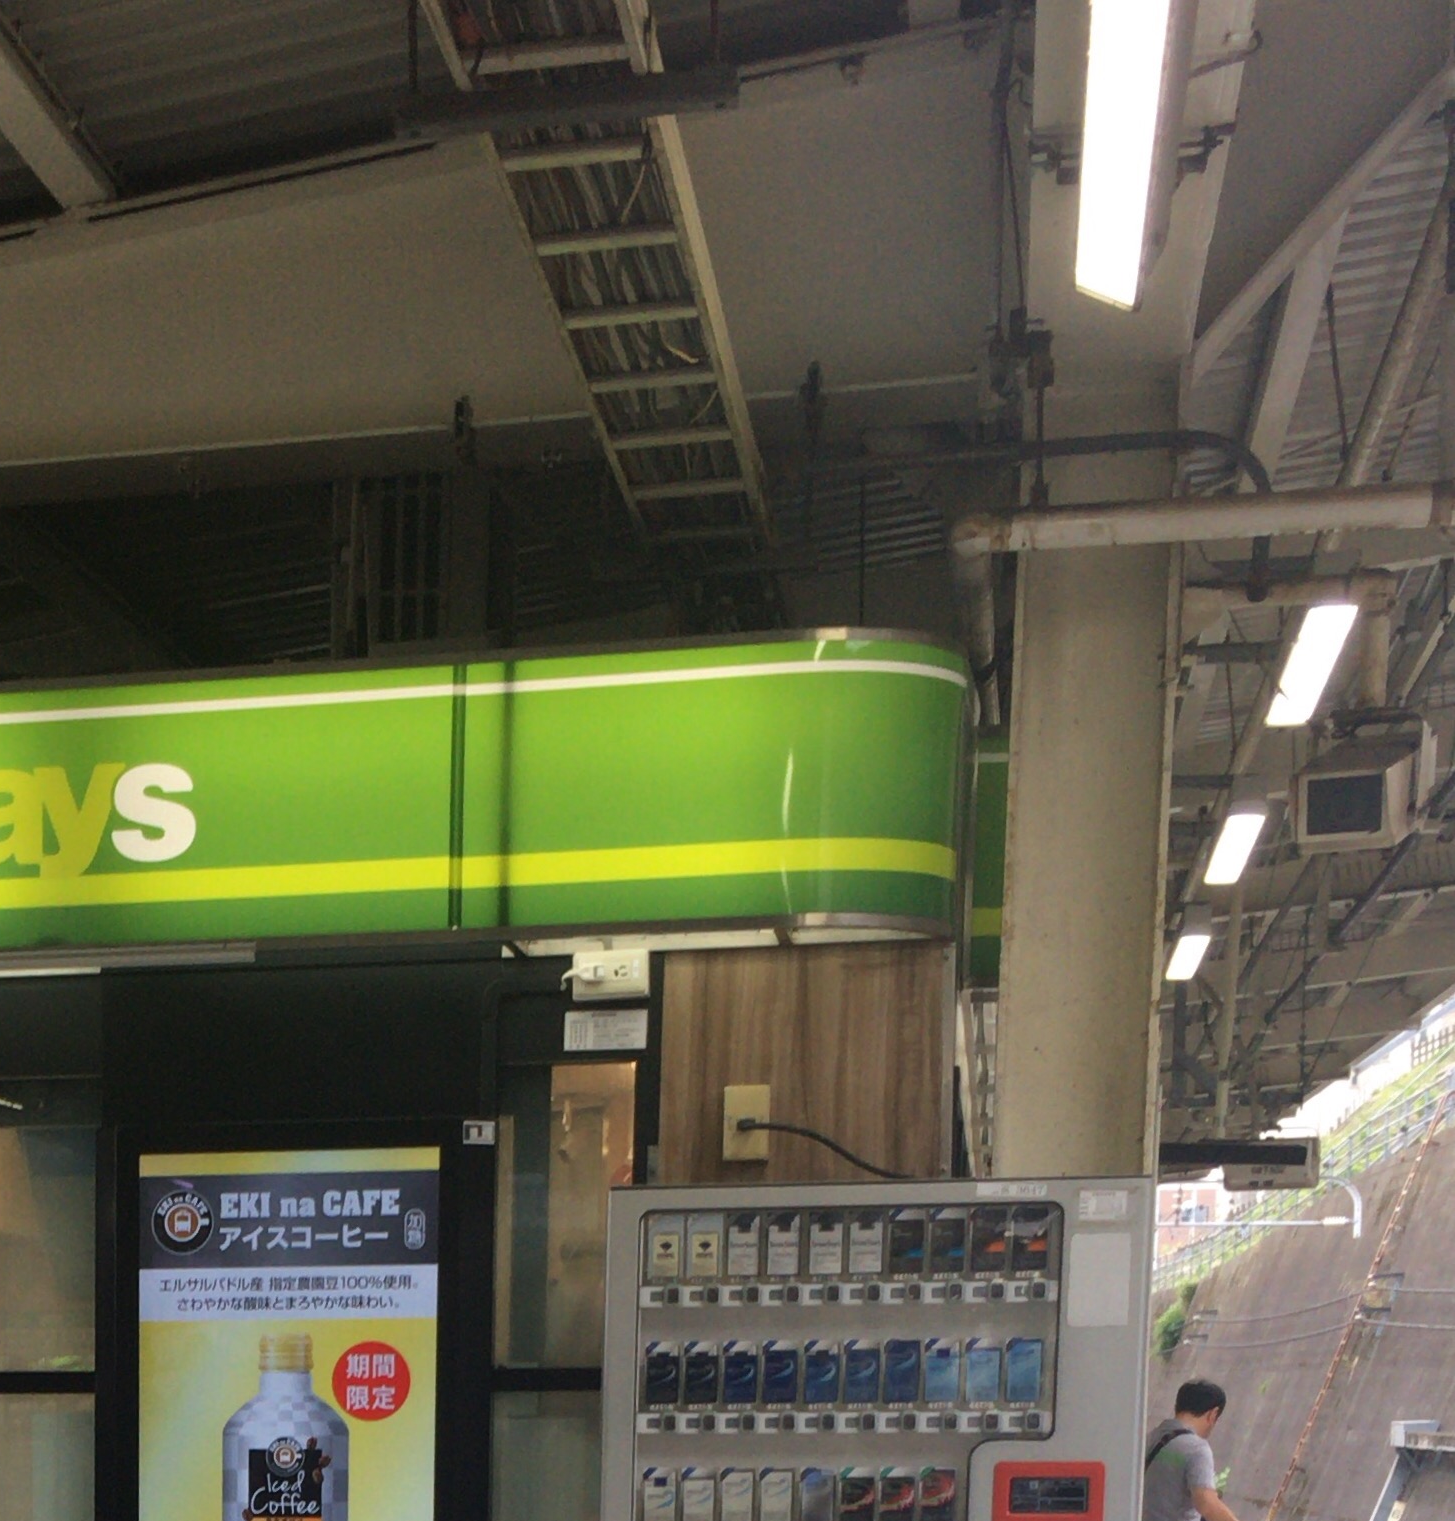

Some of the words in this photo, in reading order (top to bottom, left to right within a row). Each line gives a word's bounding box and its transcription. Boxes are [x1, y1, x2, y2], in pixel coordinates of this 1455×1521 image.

[219, 1191, 271, 1220] EKI
[279, 1196, 316, 1218] na
[322, 1188, 401, 1217] CAFE
[218, 1223, 389, 1251] アイスコーヒー
[159, 1276, 264, 1292] エルサルバドル産
[345, 1353, 396, 1380] 期間
[345, 1384, 396, 1411] 限定
[266, 1469, 306, 1493] Iced
[250, 1486, 320, 1515] Coffee
